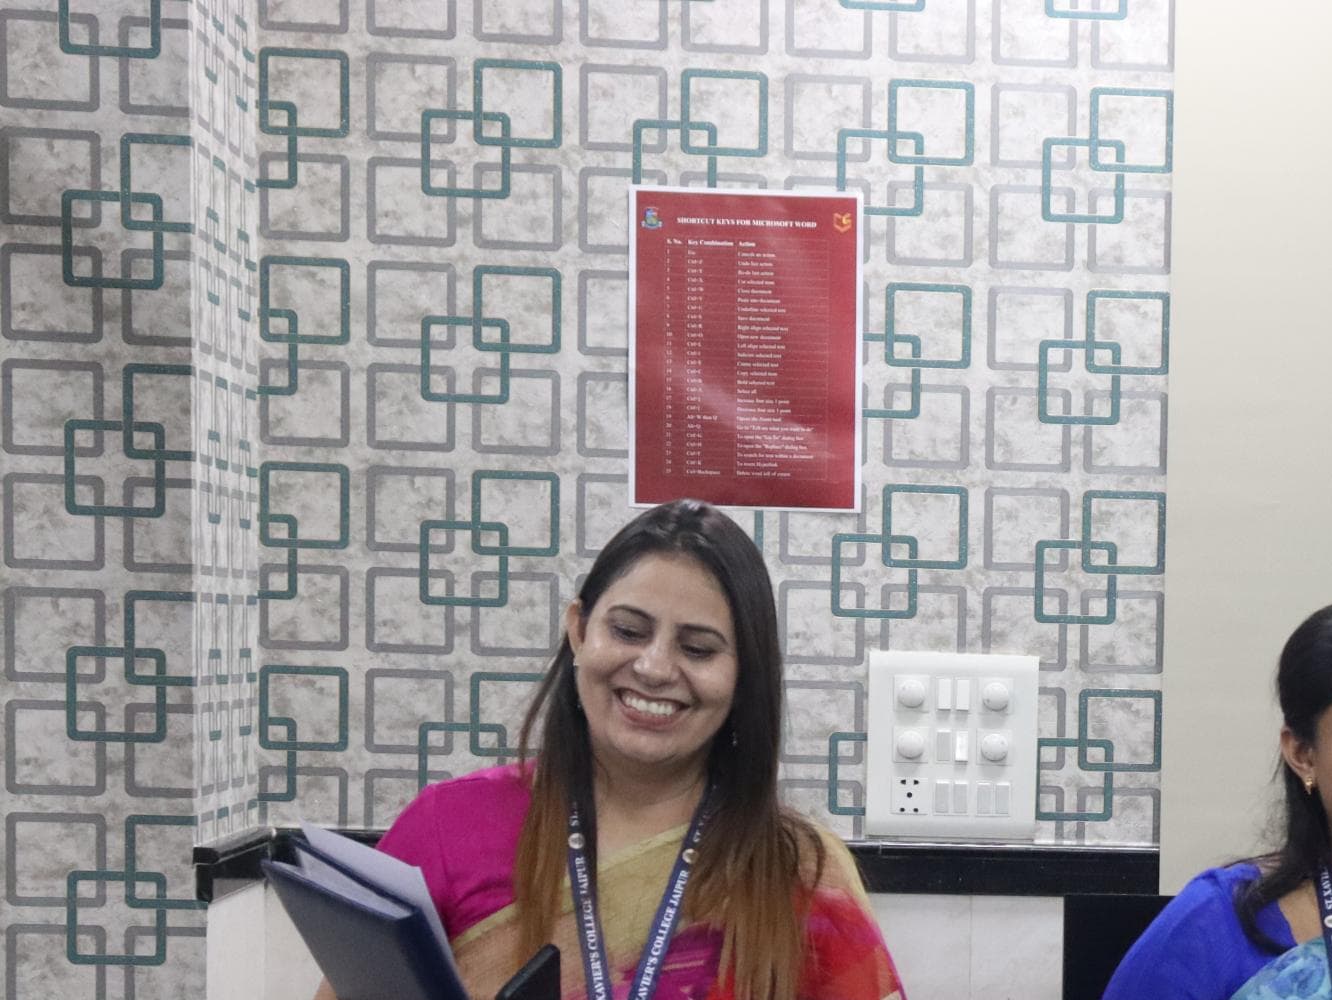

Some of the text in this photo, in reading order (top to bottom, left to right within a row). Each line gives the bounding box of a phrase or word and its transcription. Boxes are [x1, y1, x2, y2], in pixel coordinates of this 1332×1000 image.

[677, 217, 715, 226] SHORTCUT
[716, 218, 735, 226] KEYS
[752, 220, 793, 228] MICROSOFT
[651, 907, 677, 957] COLLEGE
[669, 869, 690, 907] JAIPUR
